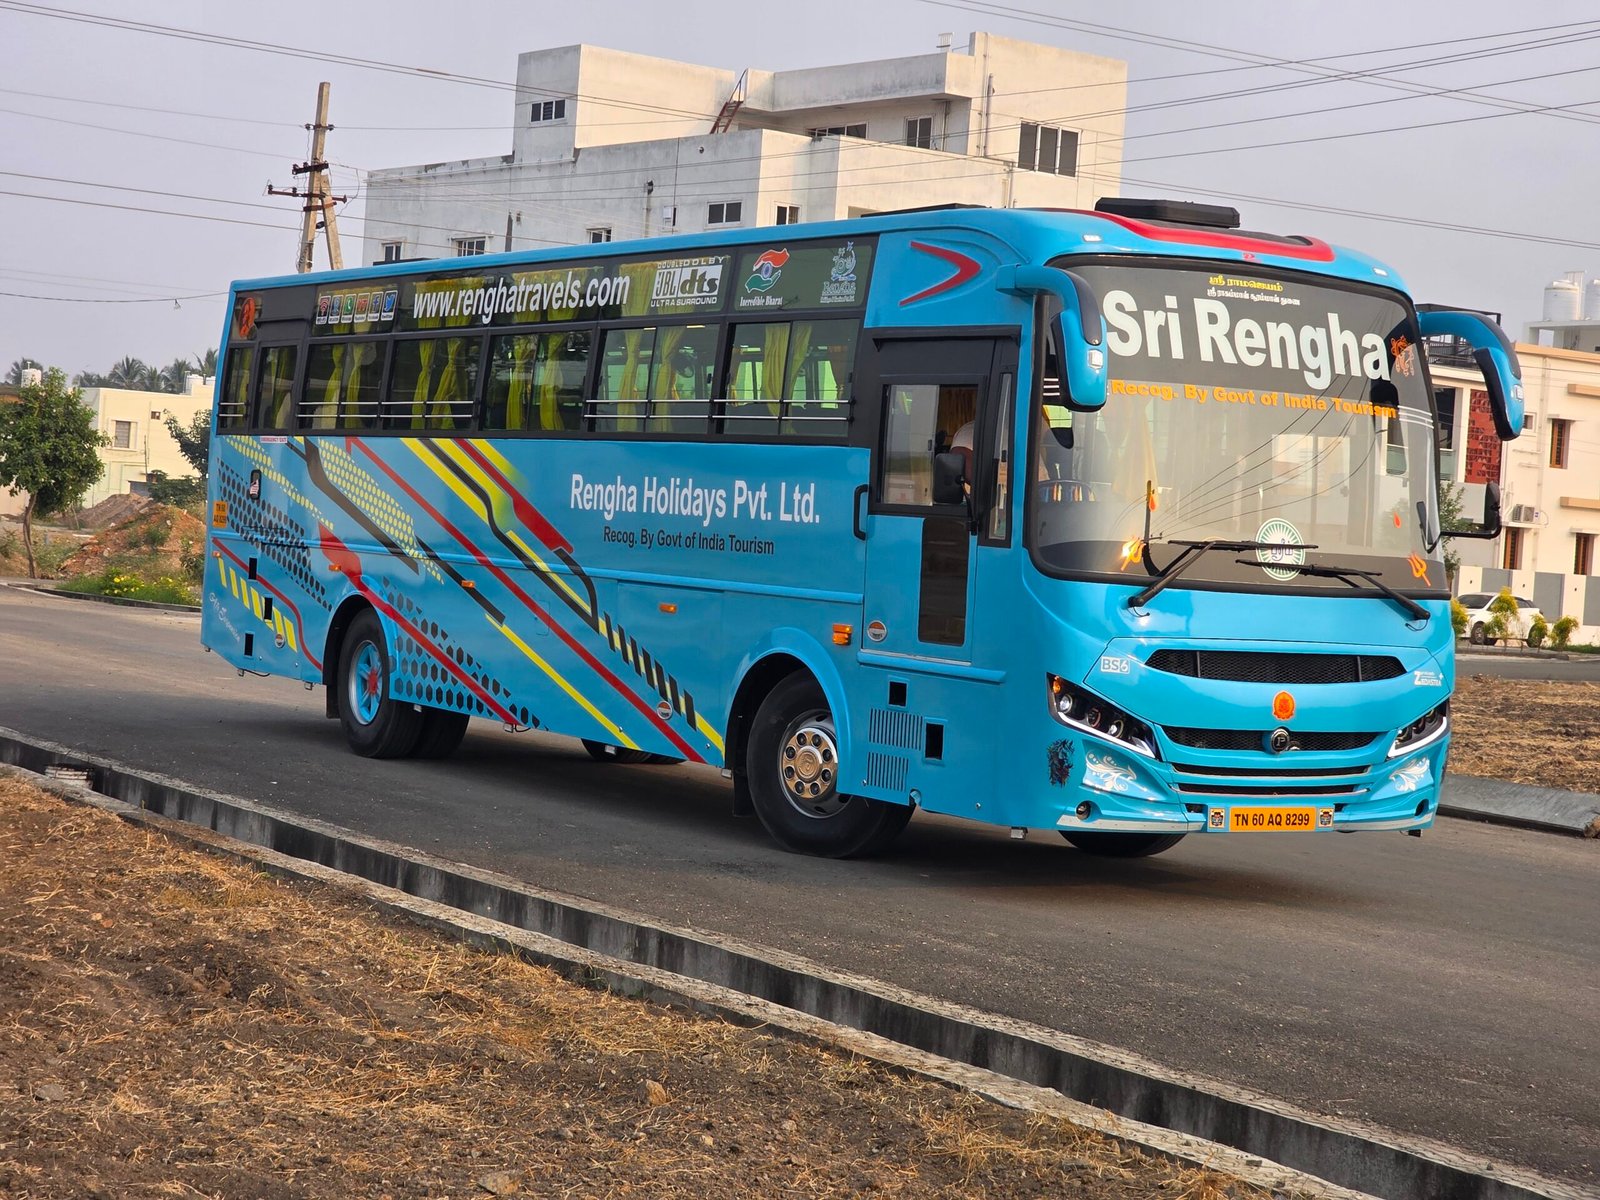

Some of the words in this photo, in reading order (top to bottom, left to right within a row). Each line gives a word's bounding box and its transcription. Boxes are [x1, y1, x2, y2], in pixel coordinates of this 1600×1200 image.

[657, 259, 683, 269] DOUBLE
[683, 256, 724, 266] DOLBY
[655, 270, 677, 297] JBL
[680, 268, 719, 295] dts
[413, 271, 631, 325] www.renghatravels.com
[650, 299, 675, 307] ULTRA
[676, 297, 718, 306] SURROUND
[740, 296, 765, 307] Incredible
[765, 295, 784, 306] Bharat
[1102, 290, 1184, 360] Sri
[1193, 297, 1391, 391] Rengha
[1111, 379, 1179, 401] Recog.
[1184, 384, 1209, 403] By
[1213, 386, 1256, 405] Govt
[1260, 391, 1279, 406] of
[1284, 392, 1328, 411] India
[1331, 397, 1397, 419] Tourism
[570, 474, 637, 521] Rengha
[643, 476, 727, 527] Holidays
[733, 480, 772, 520] Pvt.
[780, 482, 820, 523] Ltd.
[603, 526, 637, 548] Recog.
[641, 528, 654, 549] By
[657, 529, 682, 548] Govt
[685, 531, 696, 549] of
[699, 532, 725, 551] India
[729, 534, 775, 555] Tourism
[1102, 658, 1129, 673] BS6
[1234, 813, 1249, 826] TN
[1252, 813, 1264, 826] 60
[1267, 813, 1282, 826] AQ
[1285, 813, 1310, 826] 8299
